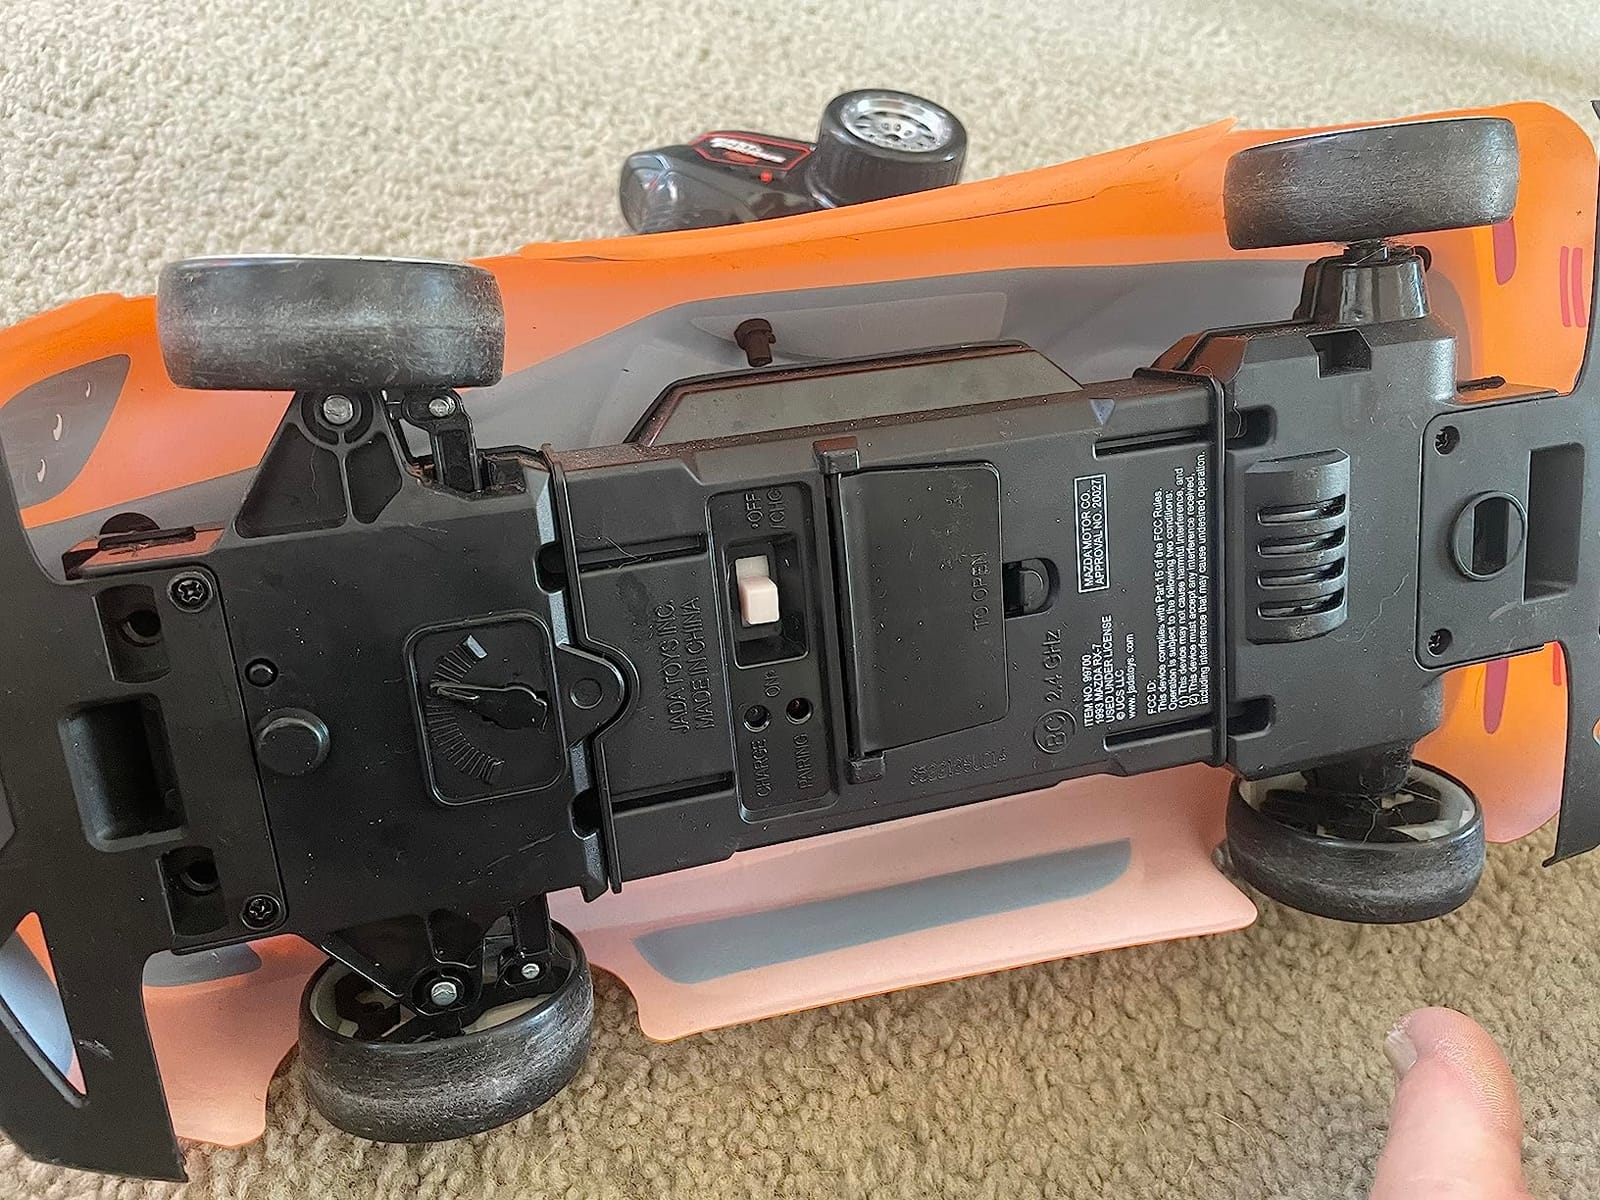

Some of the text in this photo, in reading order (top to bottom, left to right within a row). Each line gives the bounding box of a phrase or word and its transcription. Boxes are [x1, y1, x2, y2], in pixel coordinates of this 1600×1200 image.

[1174, 467, 1184, 486] and
[746, 493, 763, 522] OFF
[1164, 490, 1174, 539] conditions:
[1080, 489, 1094, 587] MAZDA MOTOR CO.
[1091, 479, 1105, 585] APPROVAL NO. 20027
[1166, 540, 1175, 558] two
[1165, 559, 1177, 598] following
[1175, 546, 1185, 580] harmful
[1196, 451, 1210, 704] including interference that may cause undesired operation.
[970, 552, 989, 631] TO OPEN
[1152, 487, 1168, 712] This device complies with Part 15 of the FCC Rules.
[1166, 600, 1175, 614] the
[1177, 581, 1186, 608] cause
[1185, 473, 1200, 706] (2) This device must accept any interference received,
[1167, 616, 1176, 625] to
[1178, 610, 1187, 624] not
[1178, 626, 1189, 644] may
[1167, 626, 1178, 657] subject
[1178, 646, 1187, 674] device
[655, 600, 689, 733] JADA TOYS INC.
[680, 597, 714, 729] MADE IN CHINA
[1043, 629, 1062, 701] 2.4 GHz
[1102, 615, 1115, 722] USED UNDER LICENSE
[1115, 669, 1125, 688] LLC
[1082, 654, 1094, 726] ITEM NO. 99700
[1092, 643, 1105, 723] 1993 MAZDA RX-7
[1116, 689, 1125, 710] UCS
[1147, 679, 1157, 714] FCC ID:
[1168, 668, 1178, 710] Operation
[1178, 675, 1188, 695] This
[1178, 696, 1189, 708] (1)
[751, 739, 772, 797] CHARGE
[793, 733, 813, 789] PAIRING
